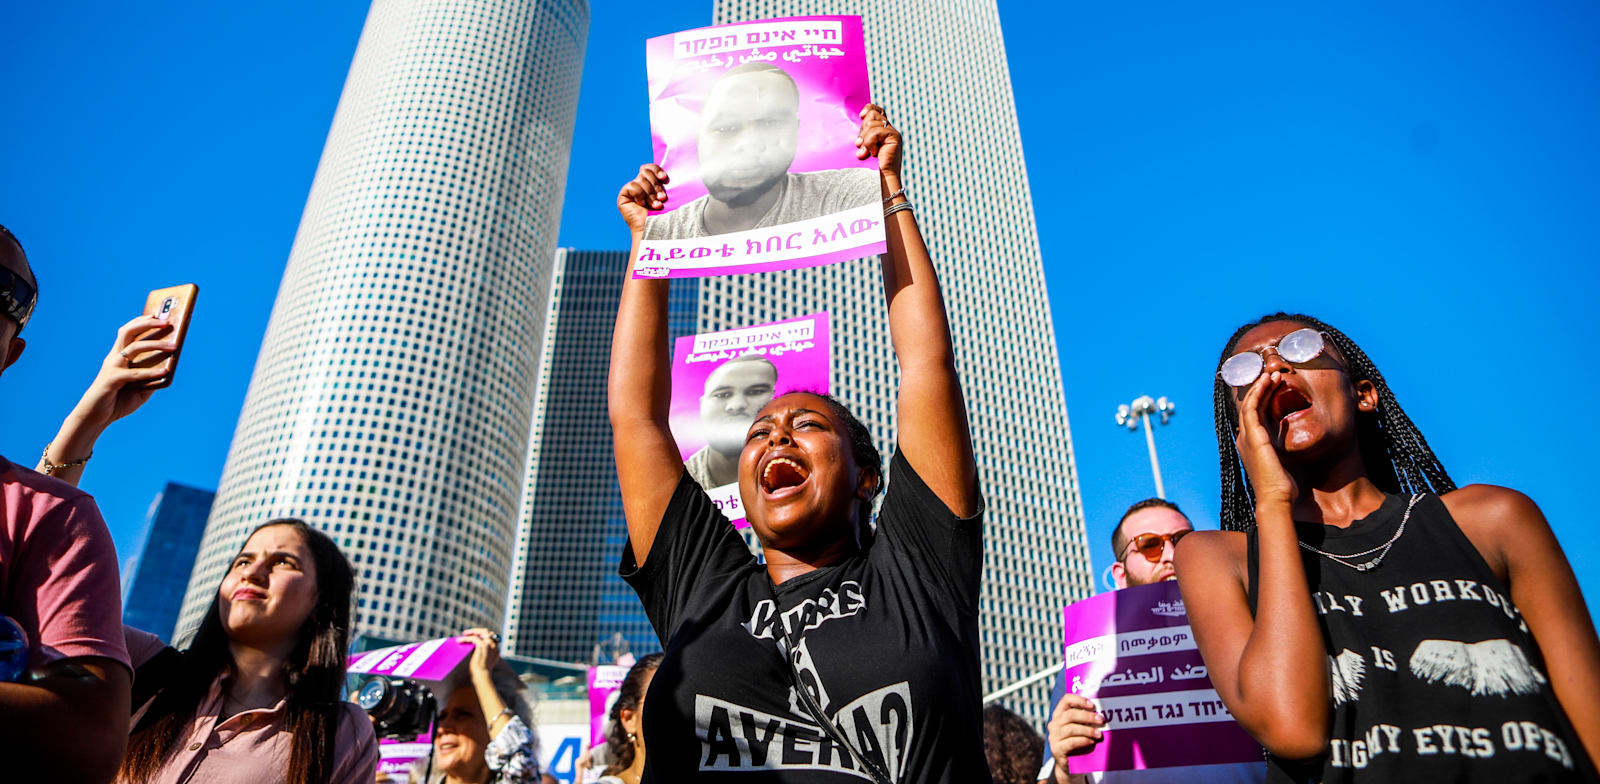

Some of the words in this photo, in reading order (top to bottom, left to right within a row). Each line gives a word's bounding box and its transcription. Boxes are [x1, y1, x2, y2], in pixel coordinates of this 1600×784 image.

[746, 30, 796, 45] אינם
[804, 28, 837, 41] חיי
[678, 34, 738, 55] הפקר
[739, 47, 778, 64] مش
[782, 44, 846, 63] حياتي
[680, 53, 735, 71] رخيص
[747, 331, 782, 344] אינם
[788, 327, 810, 337] חיי
[698, 336, 741, 351] הפקר
[738, 345, 767, 357] مش
[769, 340, 815, 356] حياتي
[684, 349, 737, 365] رخيصة
[1313, 590, 1364, 617] ILY
[1370, 646, 1397, 672] IS
[1101, 706, 1147, 723] הגזע
[1151, 703, 1184, 719] נגד
[1188, 700, 1231, 717] יחד
[1365, 723, 1402, 760] MY
[1412, 724, 1496, 759] EYES
